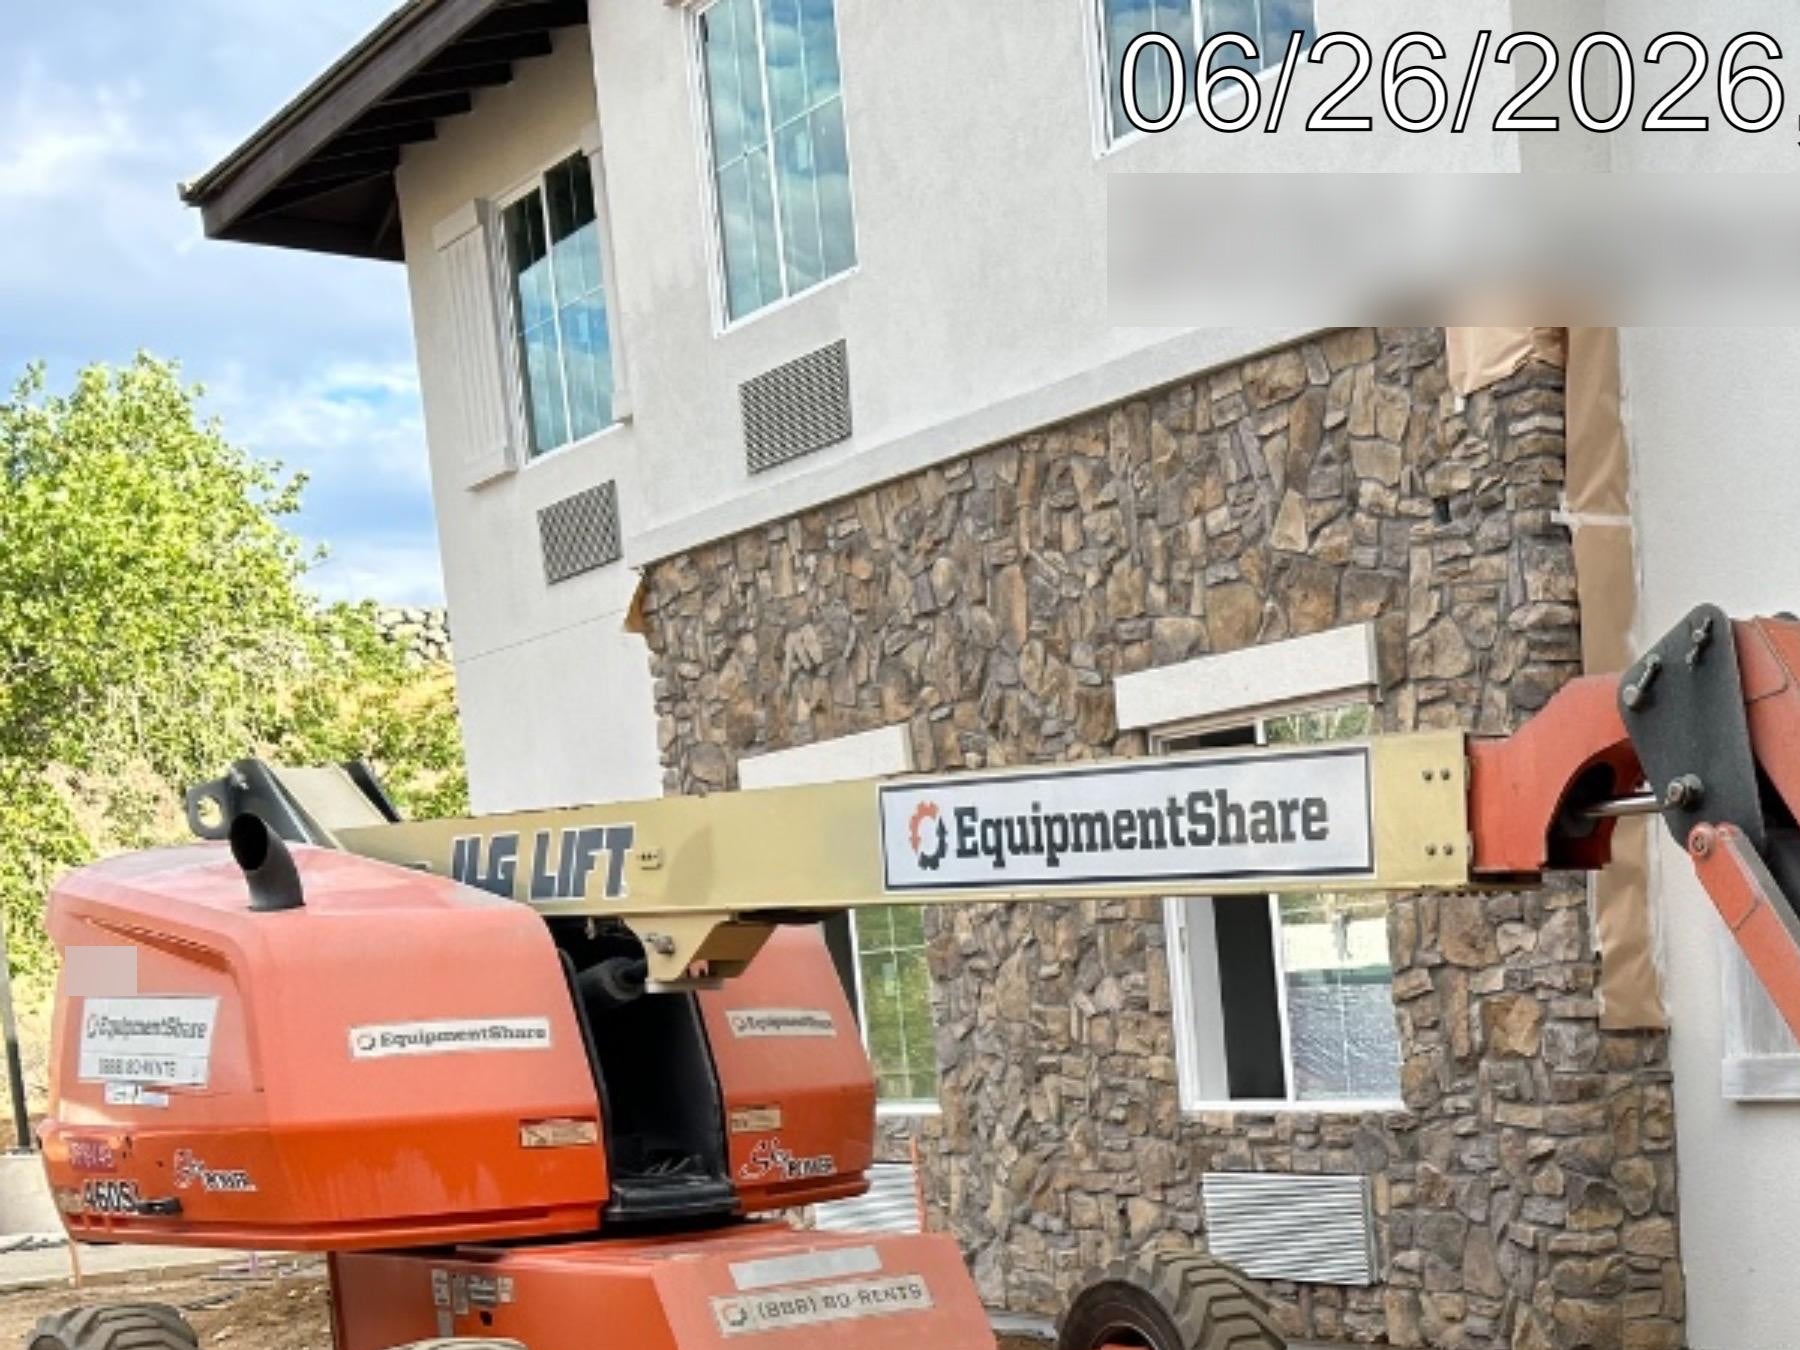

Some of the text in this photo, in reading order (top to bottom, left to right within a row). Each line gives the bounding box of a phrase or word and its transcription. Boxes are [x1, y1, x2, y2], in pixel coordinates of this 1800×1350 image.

[529, 823, 636, 900] LIFT
[954, 788, 1330, 870] EquipmentShare
[379, 1024, 547, 1048] EquipmentShare
